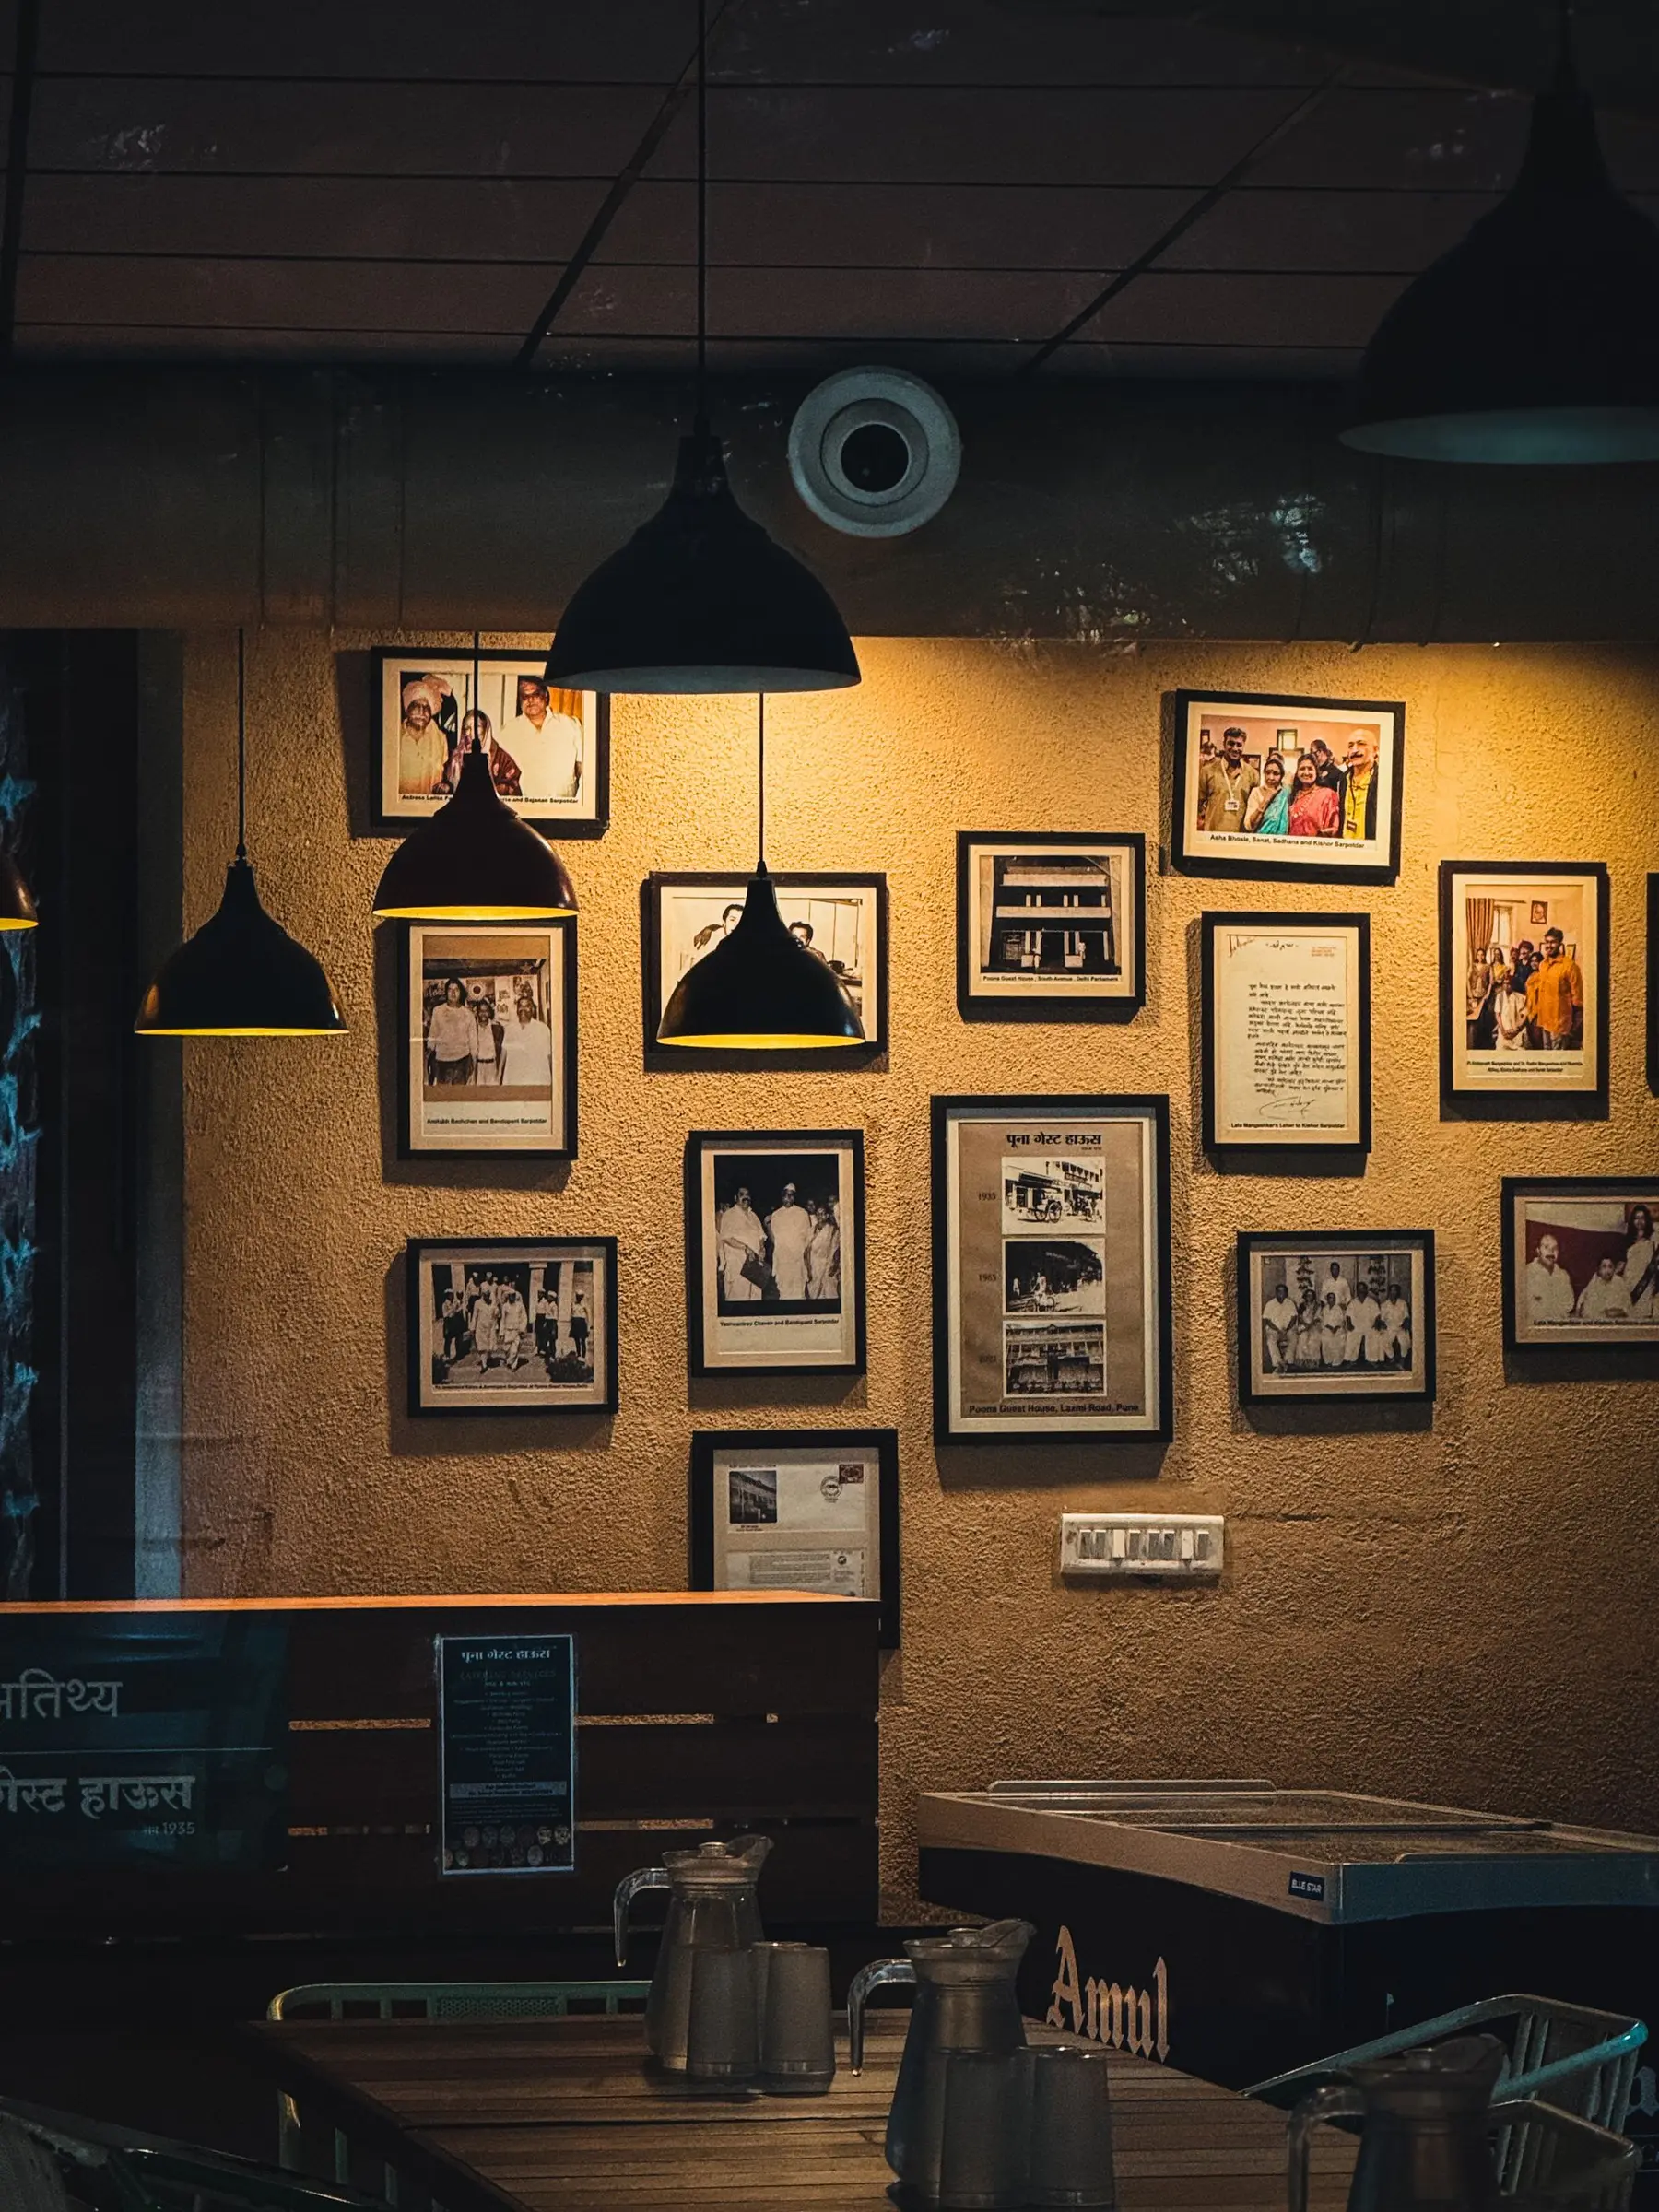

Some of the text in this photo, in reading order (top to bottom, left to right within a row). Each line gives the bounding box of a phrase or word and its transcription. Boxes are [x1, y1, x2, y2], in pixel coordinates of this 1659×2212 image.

[1006, 1131, 1101, 1149] पूना गेस्ट हाऊस
[969, 1405, 997, 1414] Poona
[1000, 1405, 1025, 1413] Guest
[1028, 1404, 1058, 1413] House,
[1061, 1404, 1086, 1413] Laxmi
[1116, 1403, 1139, 1412] Pune
[487, 1649, 512, 1660] गेस्ट
[515, 1650, 550, 1660] हाऊस
[78, 1775, 195, 1819] हाऊस
[162, 1821, 195, 1835] 1935
[1291, 1878, 1322, 1894] BLUE STAR
[1046, 1925, 1170, 2045] Amul
